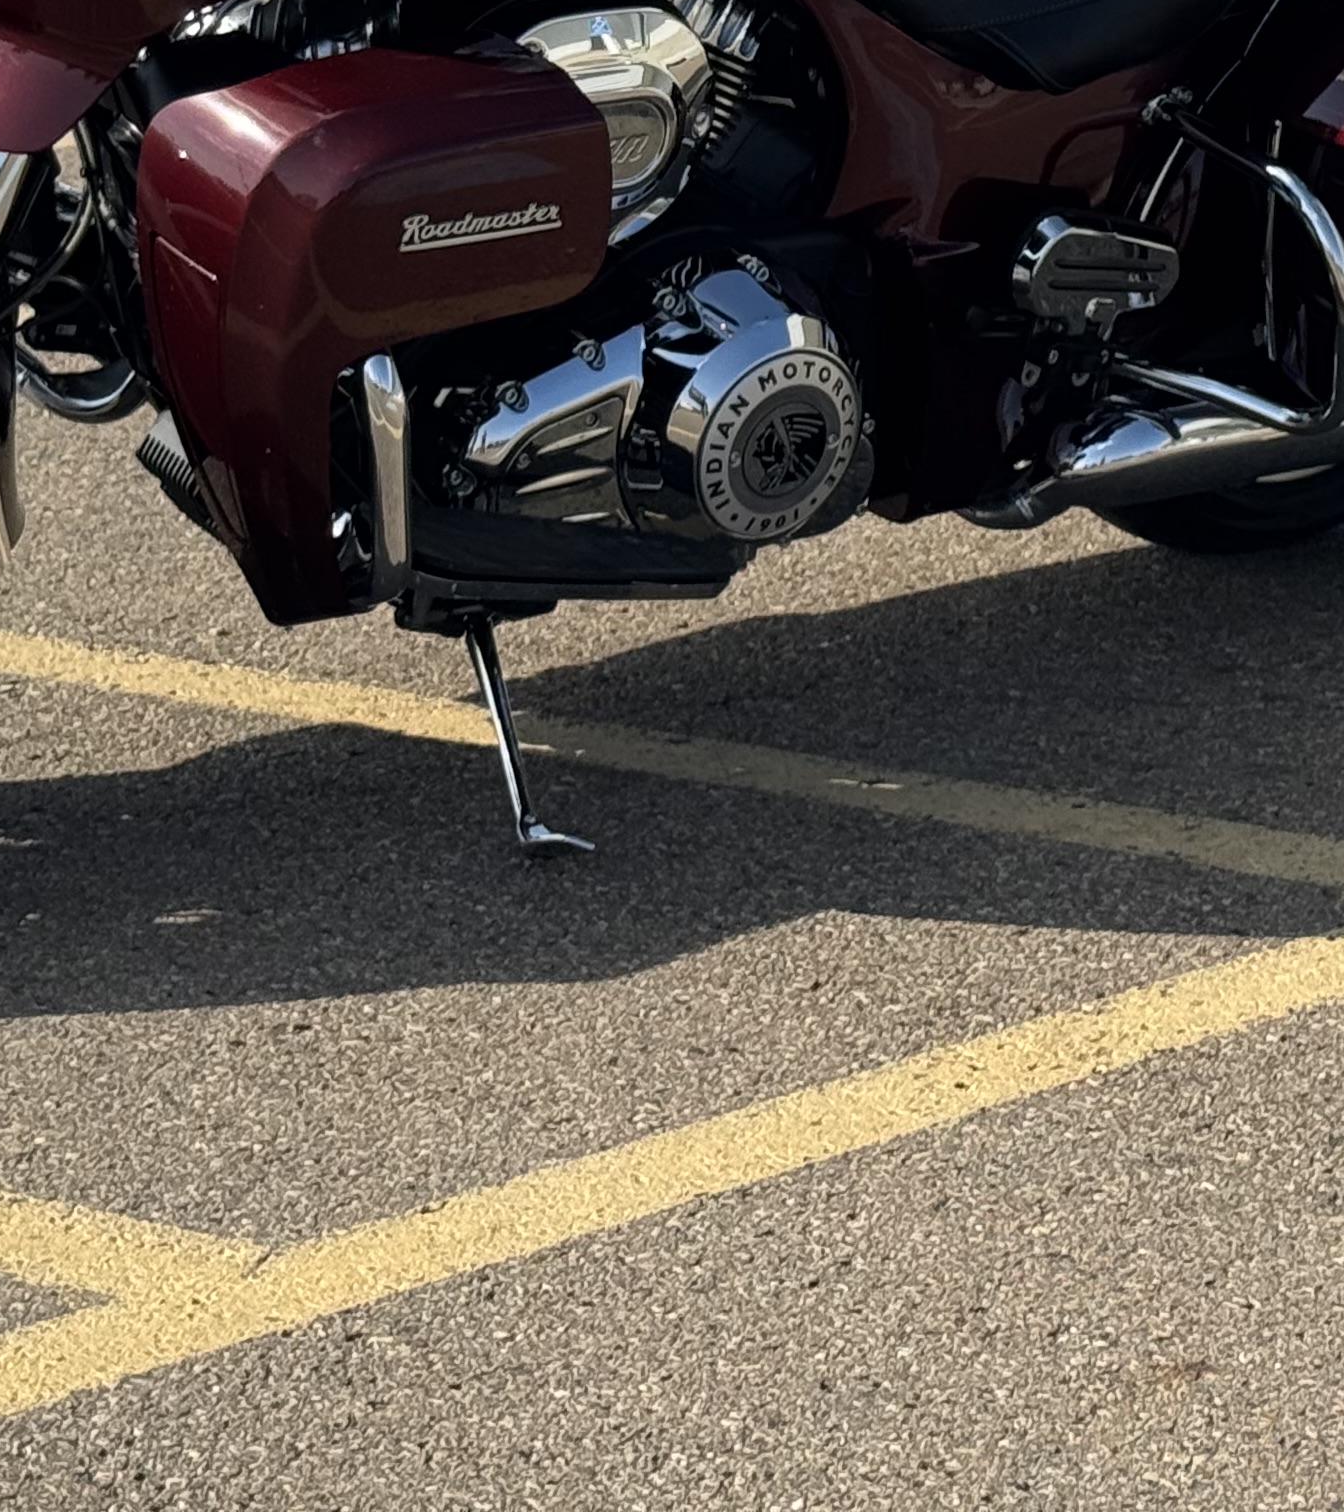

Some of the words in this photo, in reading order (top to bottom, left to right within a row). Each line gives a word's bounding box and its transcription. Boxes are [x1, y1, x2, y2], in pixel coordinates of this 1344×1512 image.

[401, 203, 560, 245] Roadmaster
[706, 394, 750, 511] INDIAN
[757, 361, 854, 487] MOTORCYCLE
[744, 508, 800, 532] 1901
